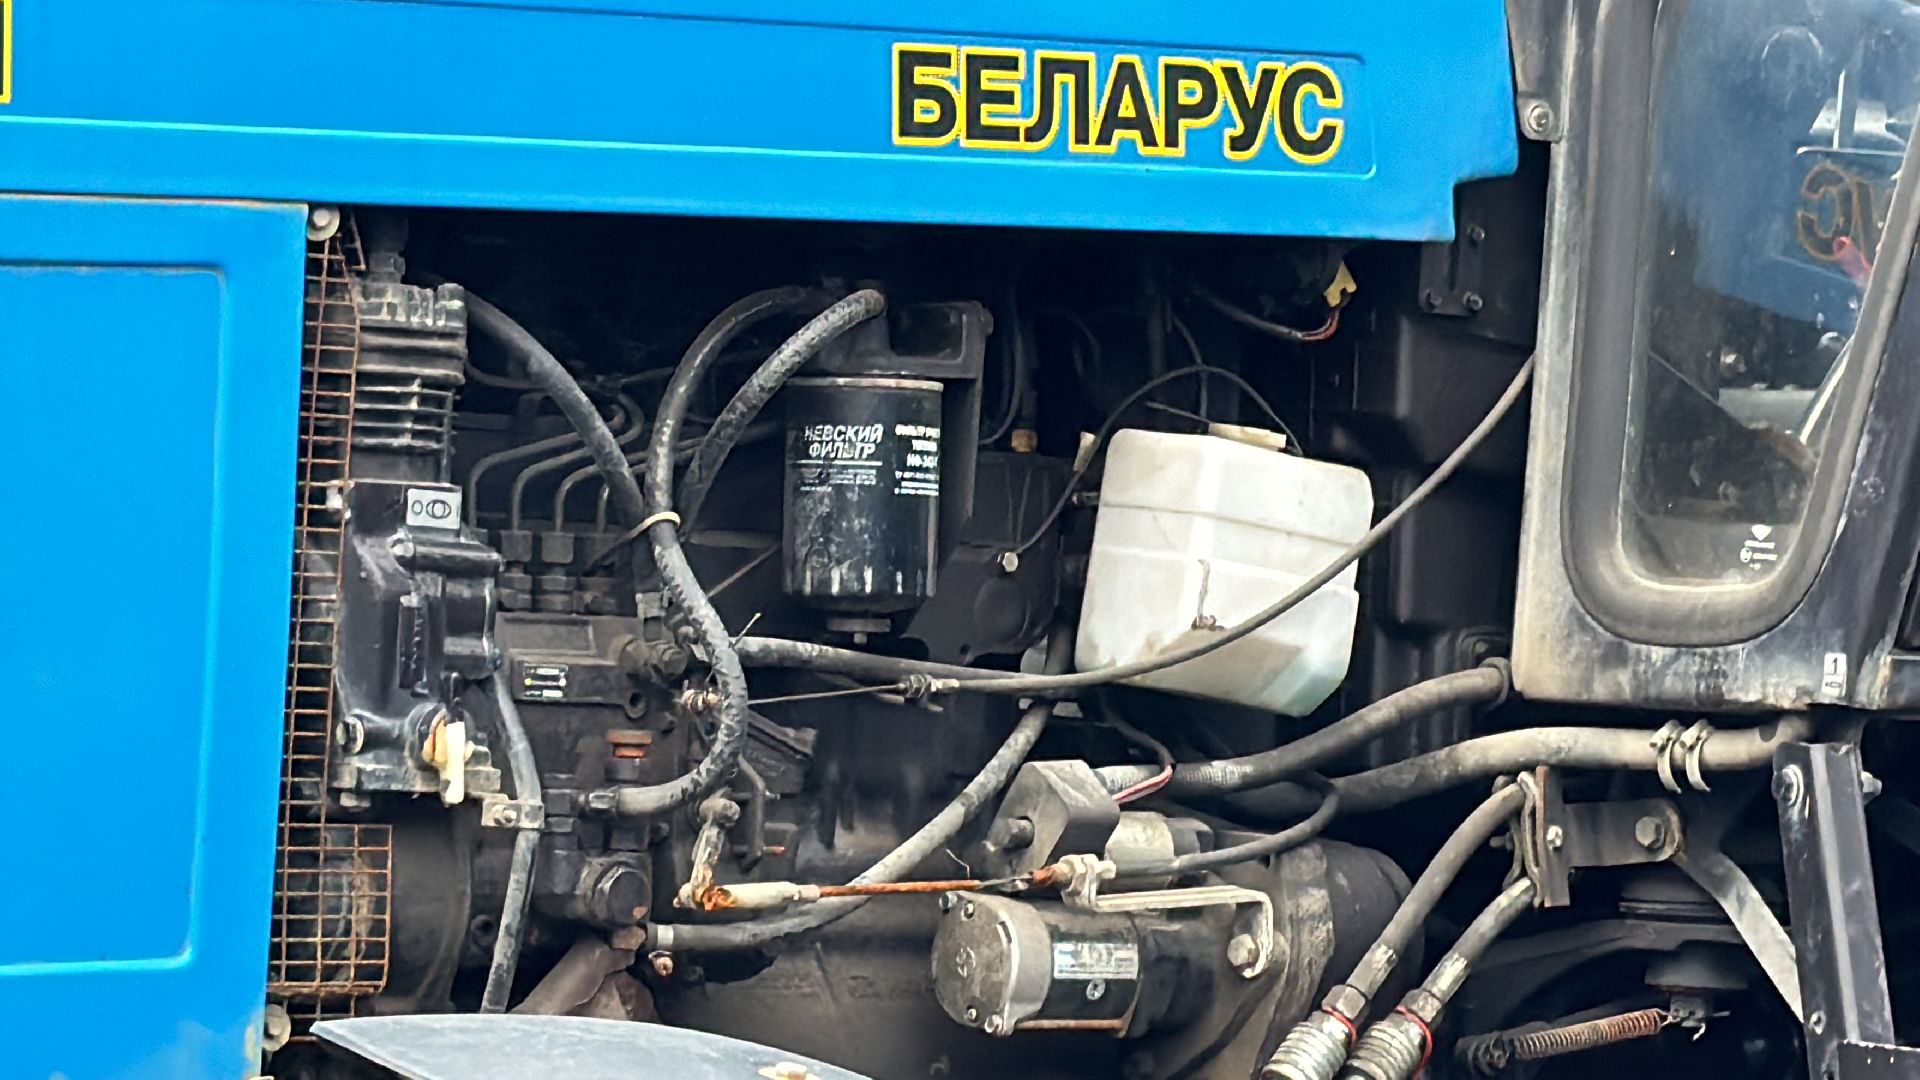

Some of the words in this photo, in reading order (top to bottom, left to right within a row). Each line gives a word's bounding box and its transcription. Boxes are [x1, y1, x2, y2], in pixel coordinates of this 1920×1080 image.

[892, 42, 1344, 164] БЕЛАРУС
[804, 424, 885, 443] НЕВСКИЙ
[809, 441, 876, 459] ФИЛЬТР
[1832, 658, 1839, 674] 1
